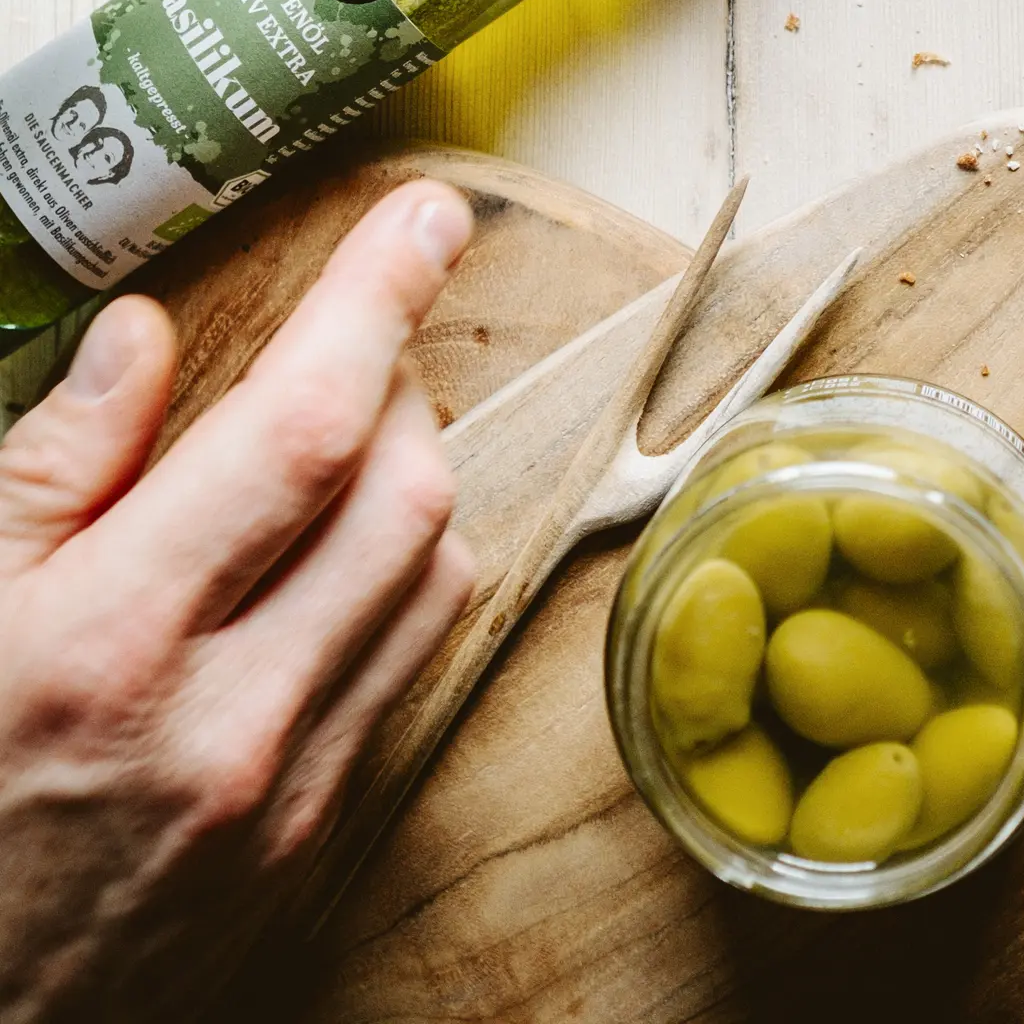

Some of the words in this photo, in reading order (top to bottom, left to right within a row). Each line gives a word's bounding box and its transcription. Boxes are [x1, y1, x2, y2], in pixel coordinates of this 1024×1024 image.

[256, 13, 316, 87] EXTRA
[127, 51, 187, 134] kaltgepresst
[6, 171, 41, 216] gewonnen,
[39, 215, 55, 230] mit
[12, 143, 29, 169] extra,
[26, 167, 48, 193] direkt
[43, 192, 58, 209] aus
[55, 205, 77, 232] Oliven
[24, 112, 40, 132] DIE
[33, 130, 93, 211] SAUCENMACHER
